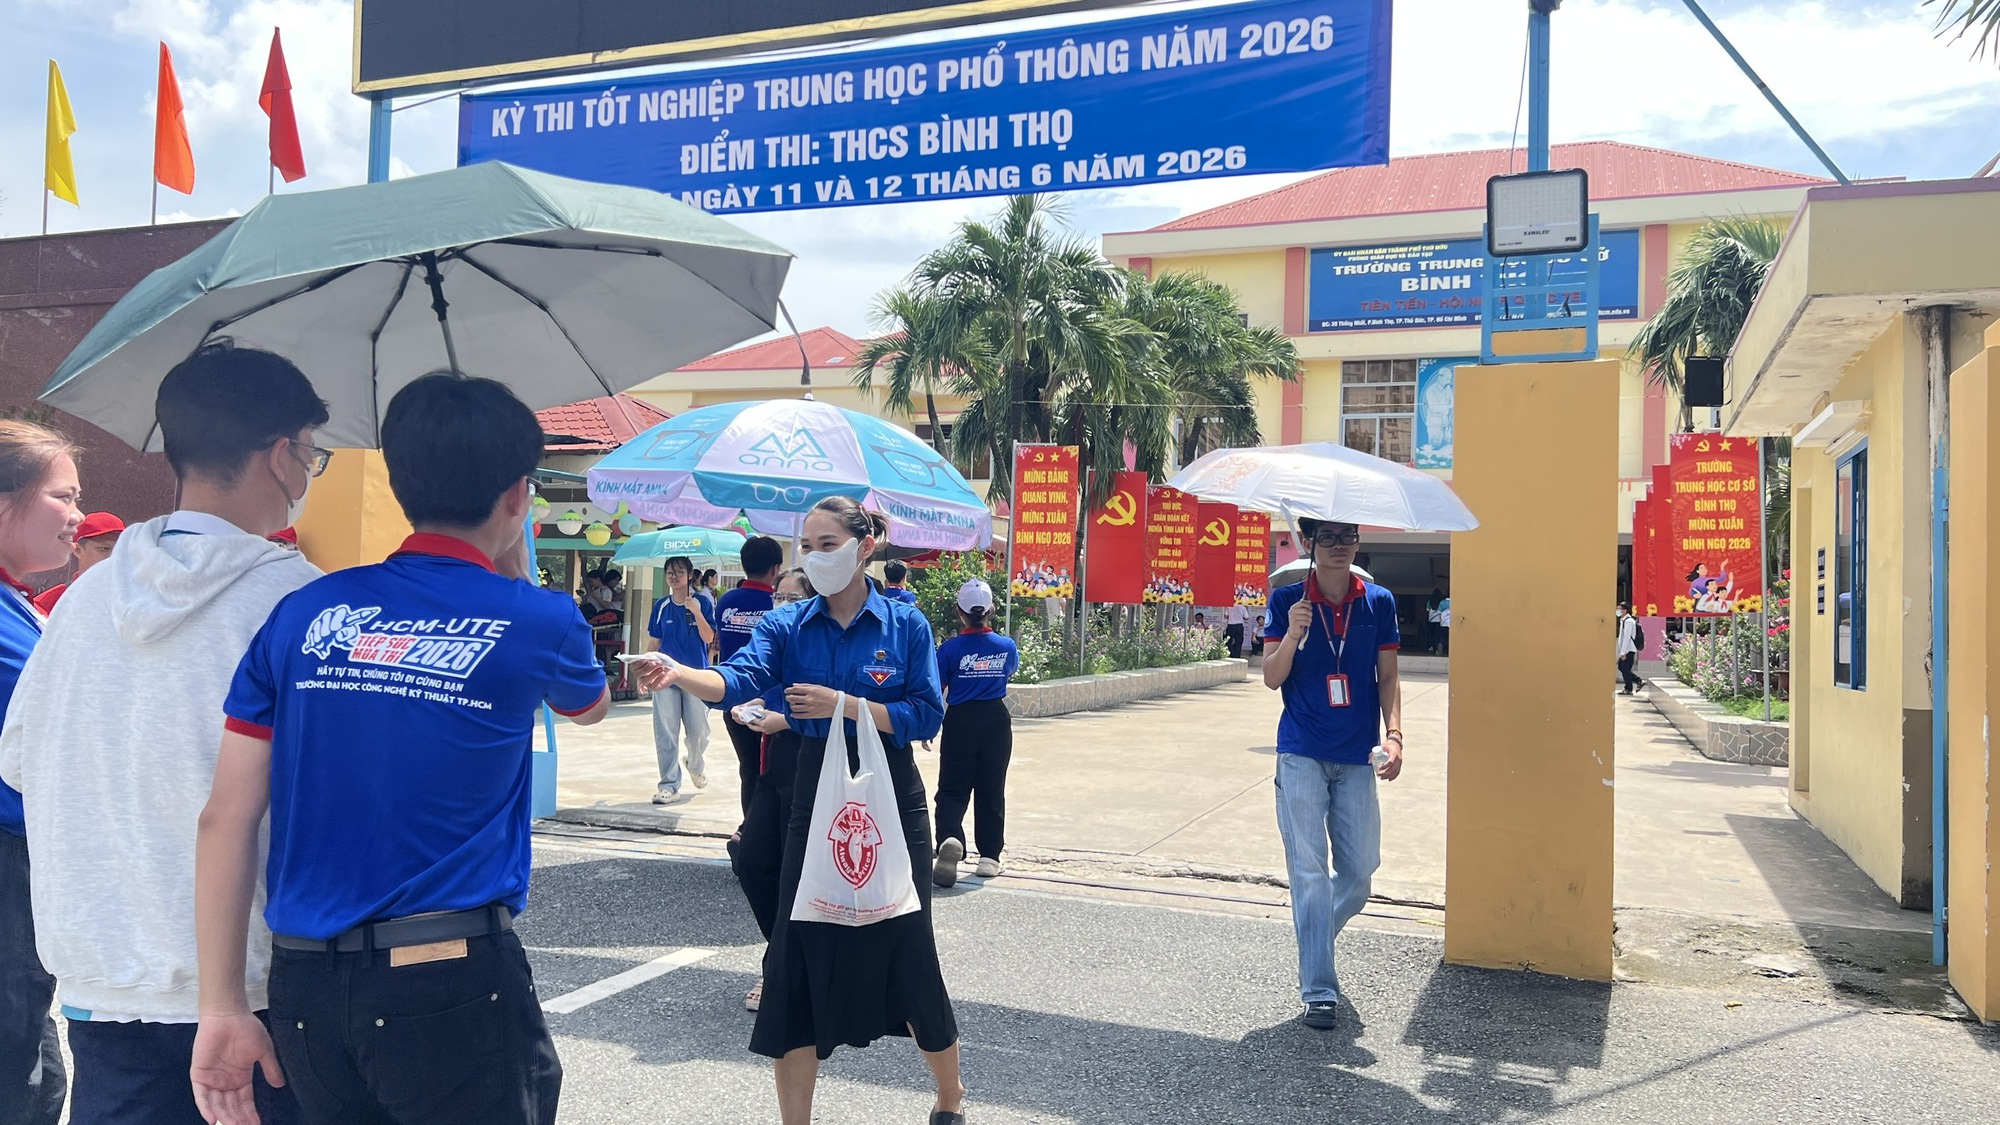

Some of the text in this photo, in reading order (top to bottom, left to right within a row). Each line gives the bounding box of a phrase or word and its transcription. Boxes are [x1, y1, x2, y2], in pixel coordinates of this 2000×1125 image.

[491, 15, 1335, 137] KỲ THI TỐT NGHIỆP TRUNG HỌC PHỔ THÔNG NĂM 2026
[680, 109, 1073, 176] ĐIỂM THI: THCS BÌNH THỌ
[681, 146, 1248, 210] NGÀY 11 VÀ 12 THÁNG 6 NĂM 2026
[1332, 261, 1411, 276] TRƯỜNG
[1418, 258, 1484, 271] TRUNG
[1401, 274, 1471, 292] BÌNH
[1360, 299, 1391, 312] TIÊN
[1395, 296, 1426, 311] TIẾN
[1440, 295, 1465, 310] HỘI
[738, 453, 834, 472] anna
[1696, 459, 1733, 474] TRƯỜNG
[1023, 467, 1069, 484] MỪNG ĐẢNG
[595, 480, 620, 494] KÍNH
[642, 483, 669, 495] ANNA
[1675, 476, 1756, 495] TRUNG HỌC CƠ SỞ
[1022, 491, 1069, 505] QUANG VINH,
[1694, 497, 1736, 514] BÌNH THỌ
[889, 502, 976, 529] KÍNH MẮT ANNA
[1022, 509, 1067, 524] MỪNG XUÂN
[1688, 516, 1744, 531] MỪNG XUÂN
[663, 540, 692, 549] BIDV
[1016, 529, 1072, 547] BÍNH NGỌ 2026
[1682, 536, 1751, 552] BÍNH NGỌ 2026
[369, 618, 512, 638] HCM-UTE
[357, 634, 417, 650] TIẾP SỨC
[351, 647, 404, 663] MÙA THI
[403, 640, 482, 671] 2026
[316, 665, 333, 676] HÃY
[335, 666, 347, 678] TỰ
[347, 667, 361, 679] TIN,
[362, 668, 388, 680] CHÚNG
[405, 674, 415, 684] ĐI
[415, 676, 442, 689] CÙNG
[443, 681, 464, 692] BẠN
[296, 680, 492, 710] TRƯỜNG ĐẠI HỌC CÔNG NGHỆ KỸ THUẬT TP.HCM
